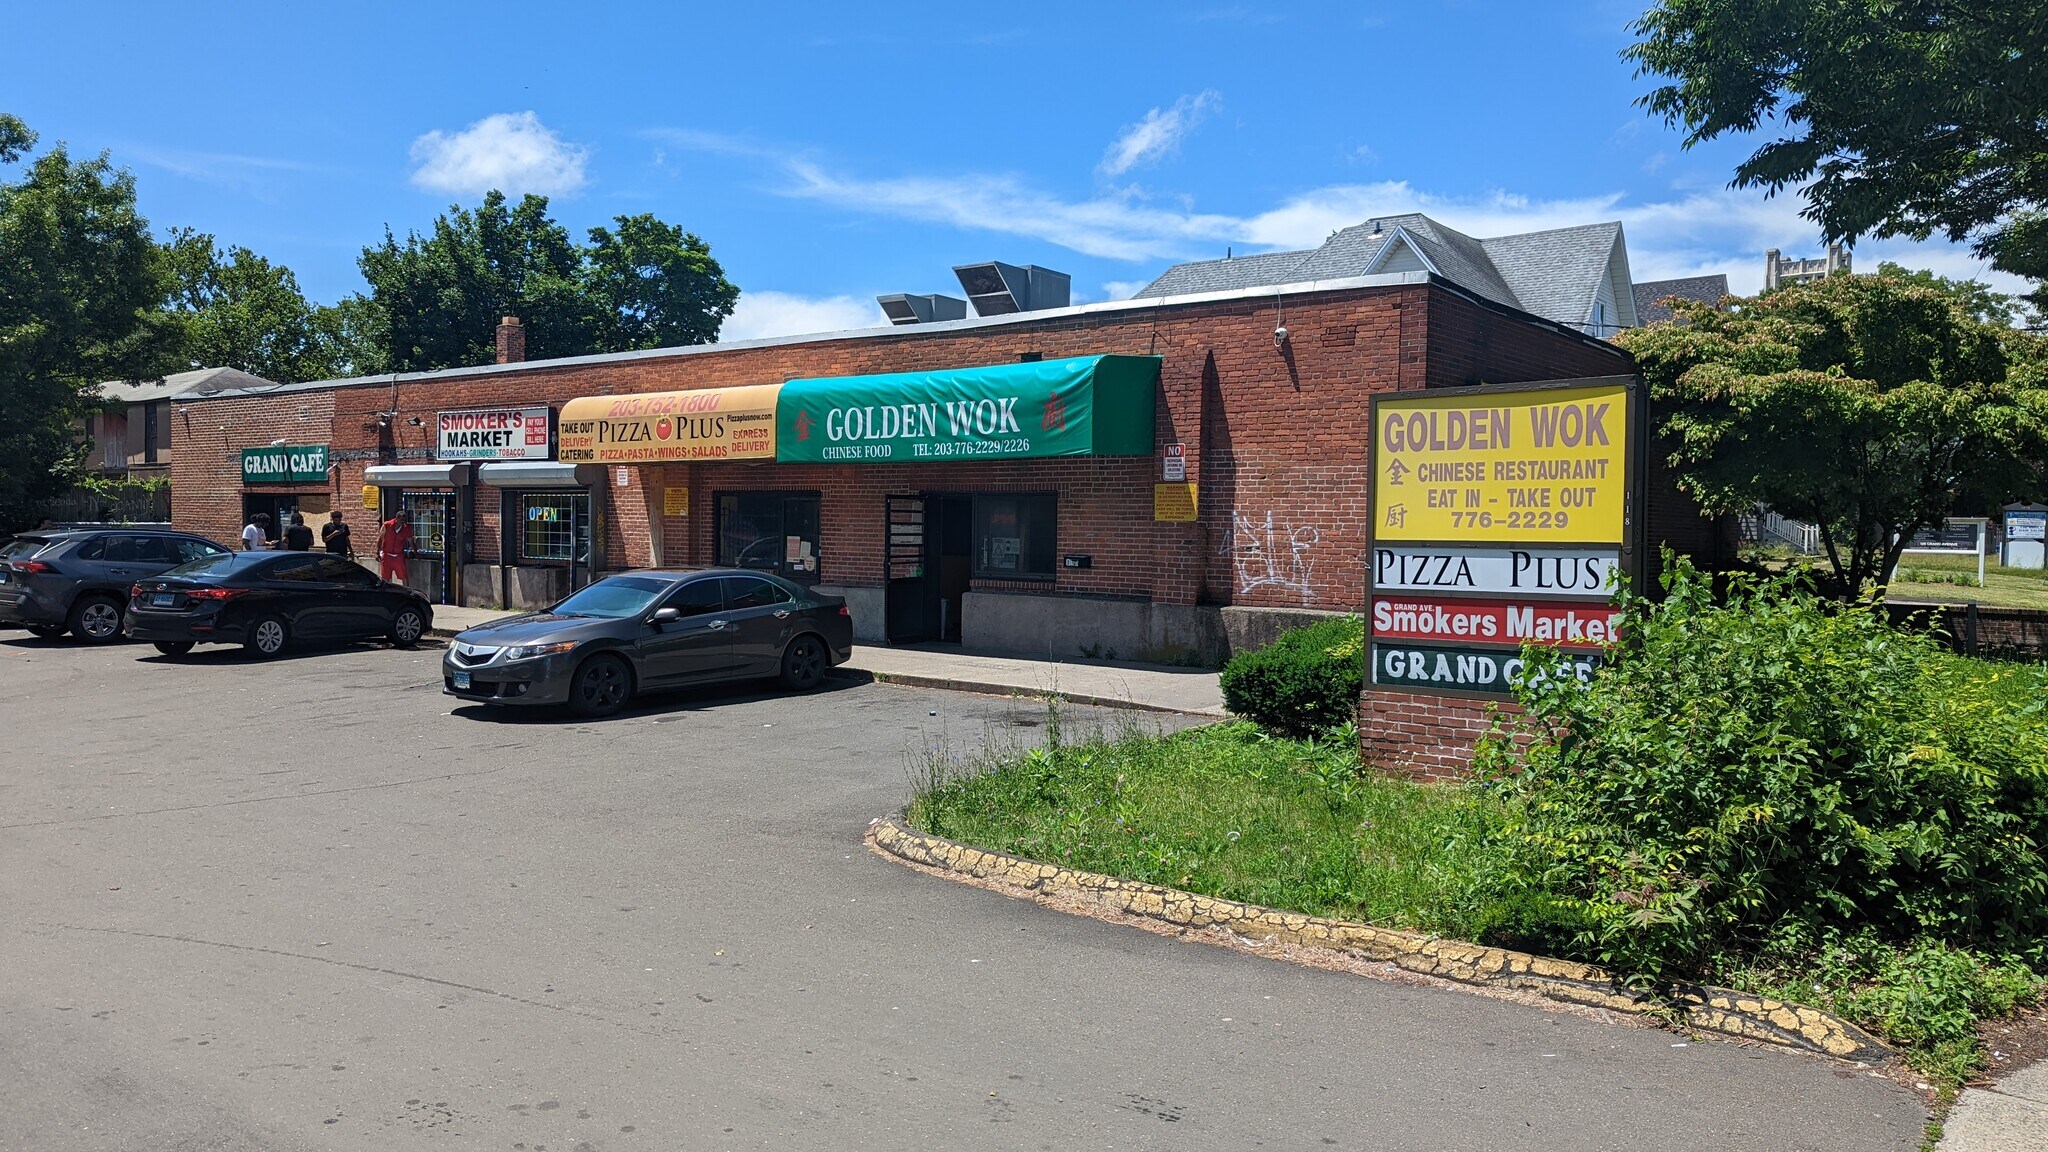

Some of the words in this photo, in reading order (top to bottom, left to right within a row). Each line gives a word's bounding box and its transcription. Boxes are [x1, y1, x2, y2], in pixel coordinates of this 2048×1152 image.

[608, 393, 722, 417] 203-752-1800
[441, 412, 523, 431] SMOKER'S
[727, 413, 772, 424] Pizzaplusnow.com
[827, 402, 938, 441] GOLDEN
[945, 396, 1020, 437] WOK
[561, 423, 579, 434] TAKE
[580, 422, 594, 433] OUT
[598, 420, 652, 443] PIZZA
[676, 416, 724, 440] PLUS
[733, 428, 769, 439] EXPRESS
[1384, 408, 1511, 453] GOLDEN
[1530, 403, 1610, 448] WOK
[447, 431, 513, 447] MARKET
[561, 437, 593, 447] DELIVERY
[732, 441, 770, 453] DELIVERY
[913, 443, 932, 457] TEL:
[934, 438, 1030, 456] 203-776-2229/2226
[499, 448, 525, 457] TOBACCO
[561, 449, 594, 460] CATERING
[600, 449, 624, 460] PIZZA
[627, 448, 654, 459] PASTA
[657, 447, 687, 458] WINGS
[691, 445, 728, 457] SALADS
[822, 445, 863, 460] CHINESE
[865, 444, 892, 459] FOOD
[1168, 446, 1181, 456] NO
[244, 454, 288, 474] GRAND
[290, 448, 324, 473] CAFÉ
[1418, 461, 1486, 482] CHINESE
[1494, 459, 1609, 481] RESTAURANT
[1427, 489, 1457, 508] EAT
[1465, 489, 1480, 508] IN
[1507, 488, 1550, 508] TAKE
[1560, 487, 1596, 508] OUT
[529, 506, 558, 522] OPEN
[1451, 511, 1569, 529] 776-2229
[1375, 549, 1477, 586] PIZZA
[1509, 551, 1601, 590] PLUS
[1394, 603, 1417, 611] GRAND
[1419, 604, 1435, 612] AVE.
[1374, 600, 1497, 637] Smokers
[1506, 605, 1618, 643] Market
[1385, 650, 1497, 684] GRAND
